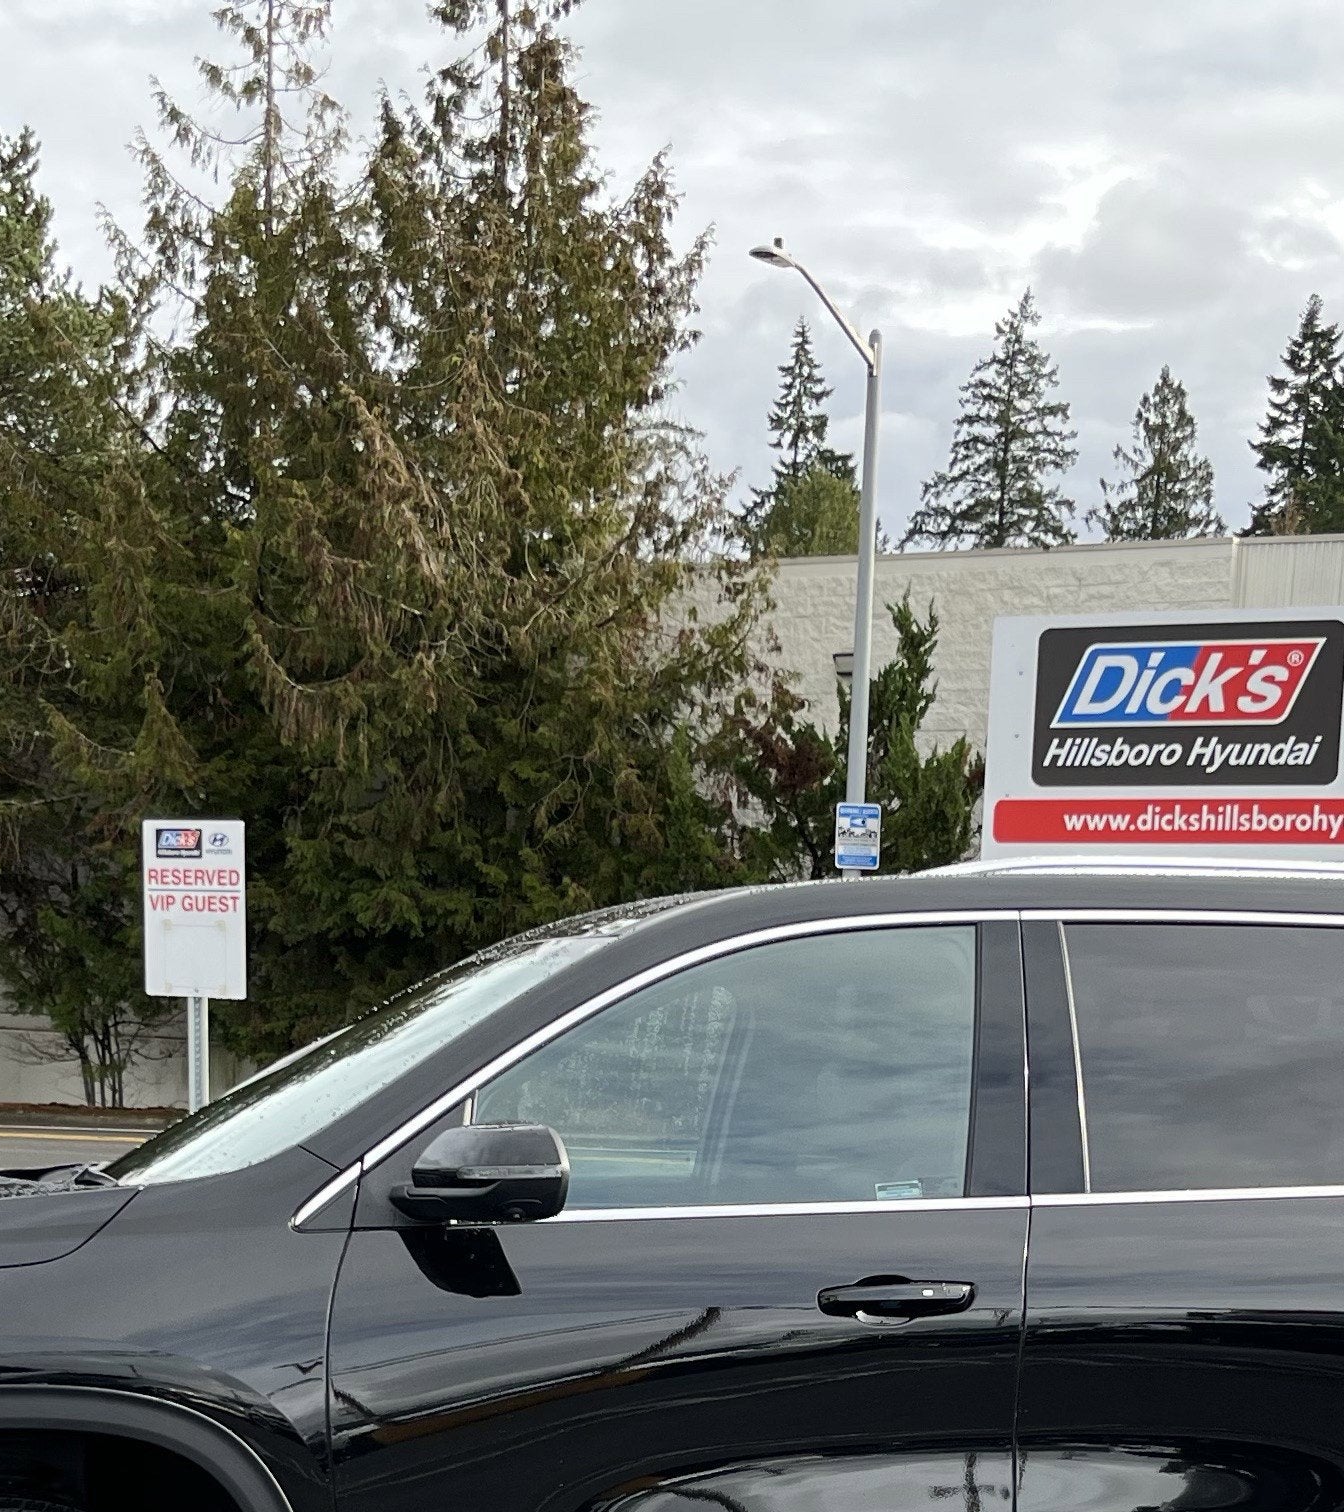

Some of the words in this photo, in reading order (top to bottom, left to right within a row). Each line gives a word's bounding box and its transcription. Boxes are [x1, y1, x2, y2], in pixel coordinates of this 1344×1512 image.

[1043, 737, 1184, 768] Hillsboro
[1186, 735, 1324, 774] Hyundai
[148, 868, 240, 886] RESERVED
[149, 894, 176, 911] VIP
[182, 895, 240, 913] GUEST
